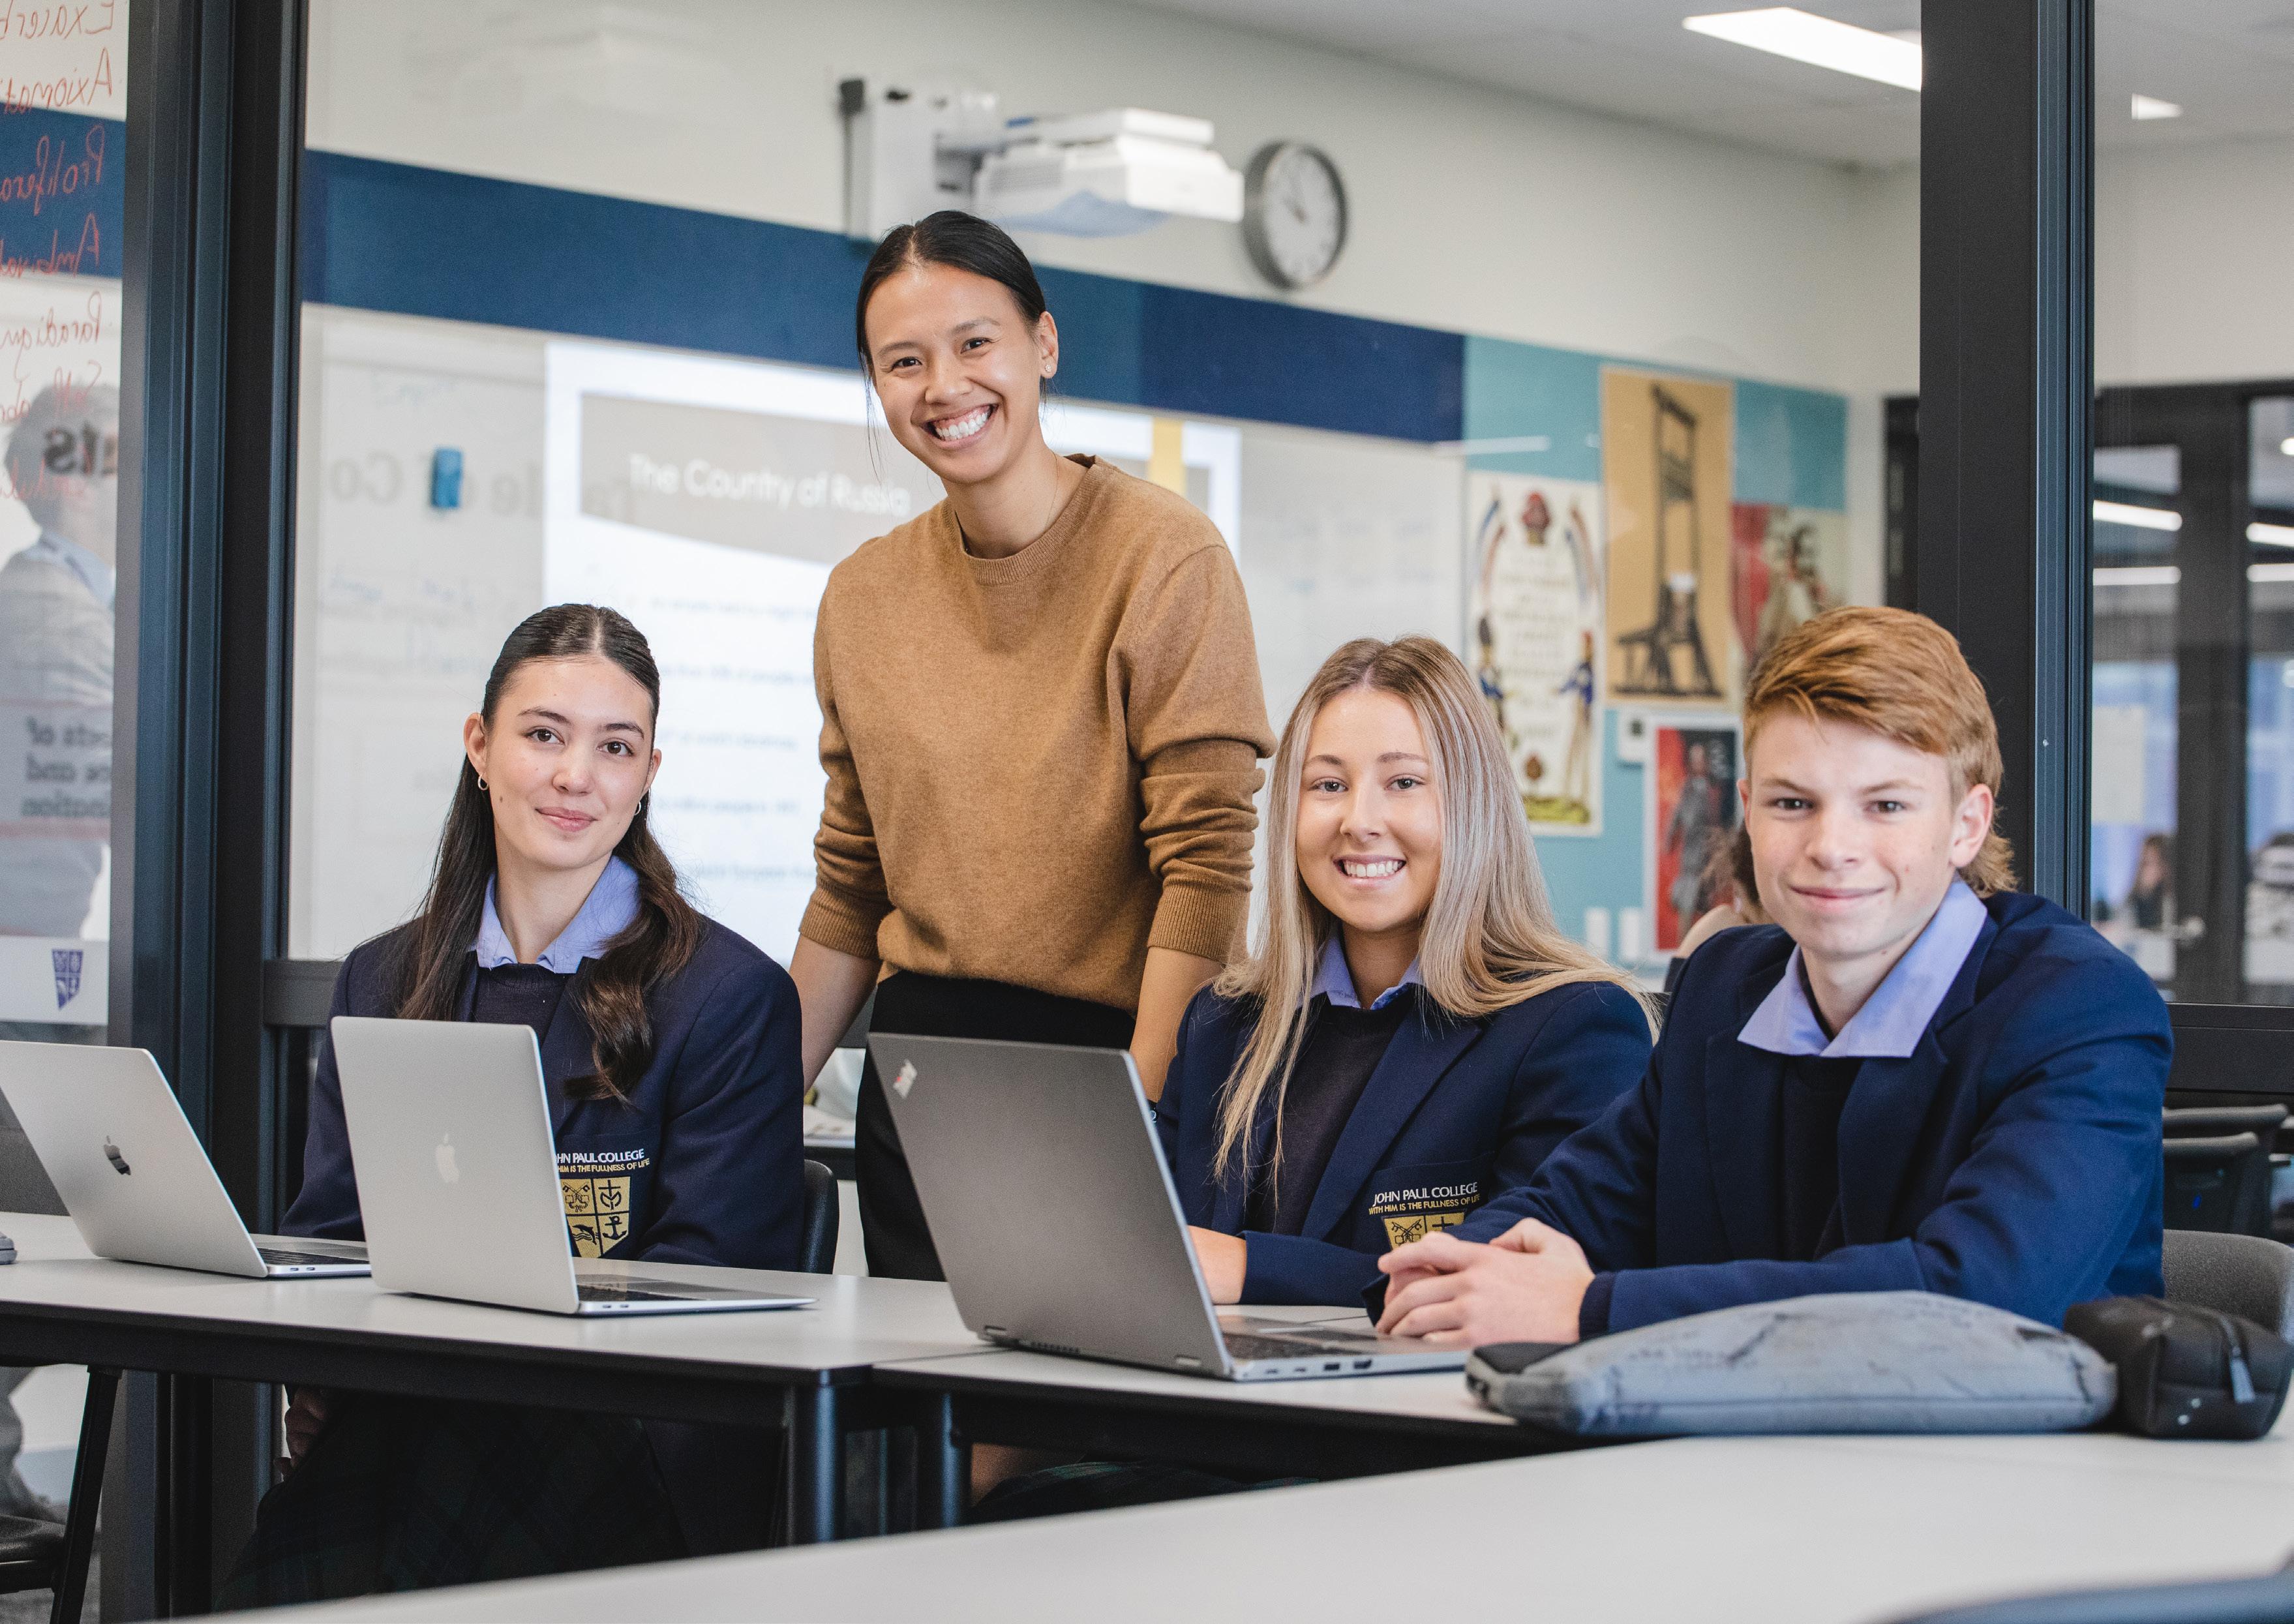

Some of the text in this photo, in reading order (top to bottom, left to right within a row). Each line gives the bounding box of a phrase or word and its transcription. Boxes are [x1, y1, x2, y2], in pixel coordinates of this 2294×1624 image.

[630, 453, 680, 495] The
[684, 459, 797, 510] Country
[556, 1149, 644, 1164] HN PAUL COLLEGE
[591, 1164, 626, 1173] FULLNESS
[1373, 1182, 1478, 1207] JOHN PAUL COLLEGE
[1368, 1205, 1383, 1215] WITH
[1423, 1199, 1459, 1209] FULLNESS
